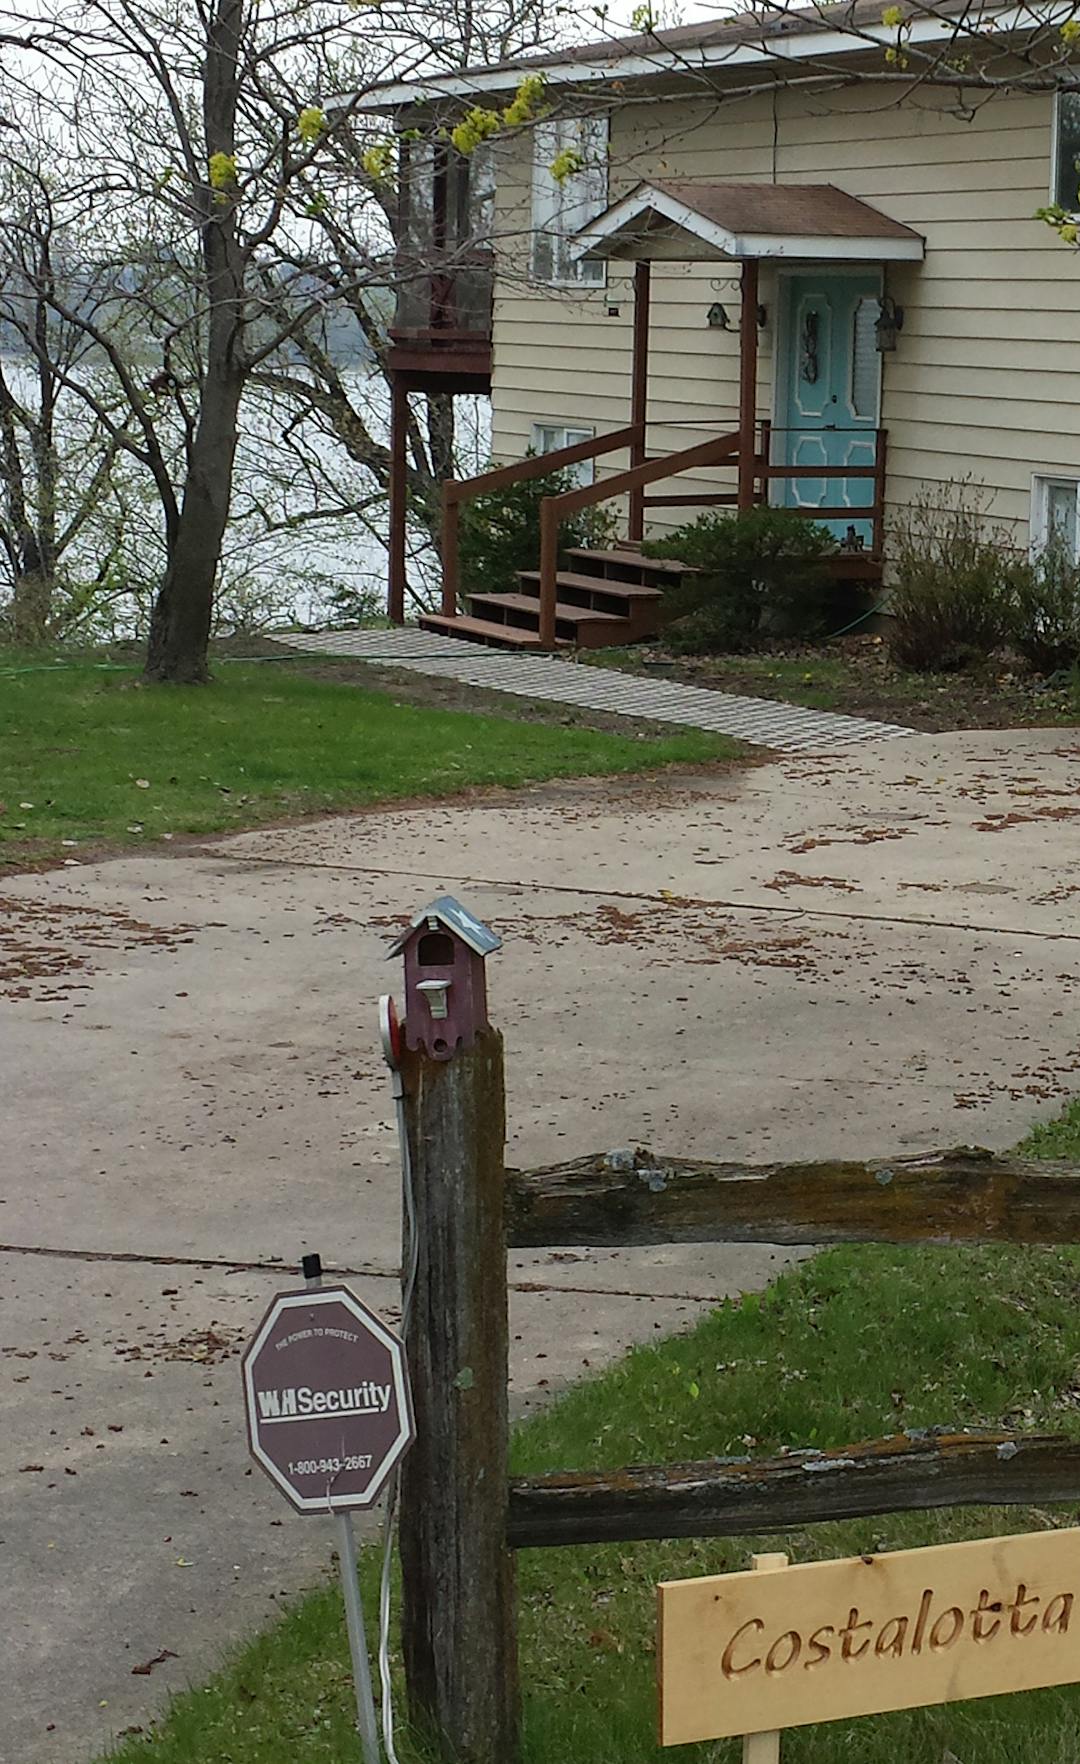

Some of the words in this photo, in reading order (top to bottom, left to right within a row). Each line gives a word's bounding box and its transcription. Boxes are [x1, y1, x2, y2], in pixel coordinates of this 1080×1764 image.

[275, 1338, 289, 1351] THE
[287, 1329, 313, 1343] POWER
[313, 1328, 324, 1337] TO
[324, 1328, 359, 1343] PROTECT
[288, 1454, 373, 1475] 1-800-943-2667
[720, 1583, 1074, 1680] Costalotta
